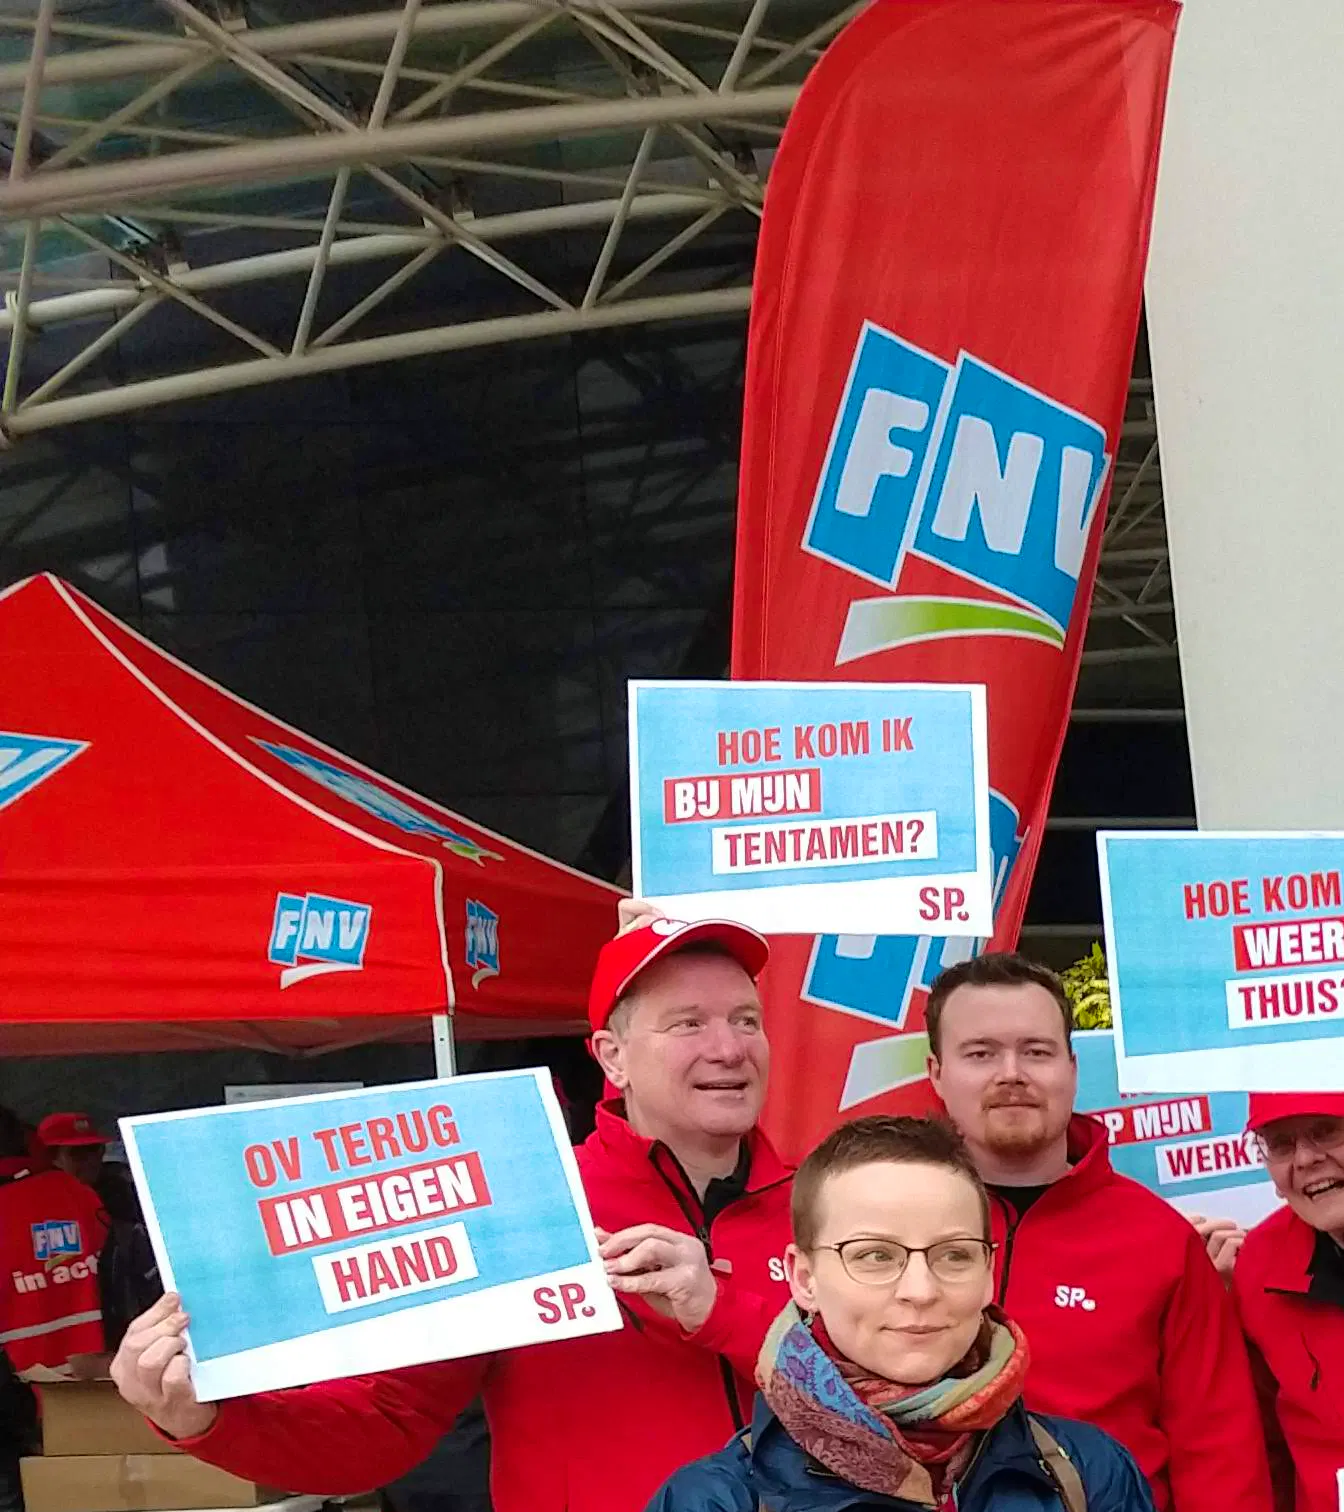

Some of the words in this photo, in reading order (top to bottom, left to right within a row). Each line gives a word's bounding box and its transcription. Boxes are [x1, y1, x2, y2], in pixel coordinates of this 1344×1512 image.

[717, 727, 782, 766] HOE
[794, 720, 870, 760] KOM
[882, 717, 914, 752] IK
[674, 780, 719, 820] BIJ
[731, 772, 811, 816] MIJN
[724, 819, 925, 867] TENTAMEN?
[1184, 879, 1251, 919] HOE
[1262, 870, 1341, 913] KOM
[275, 909, 366, 950] FNV
[244, 1136, 302, 1188] OV
[314, 1104, 461, 1172] TERUG
[1093, 1112, 1125, 1145] P
[1133, 1099, 1204, 1141] MIJN
[274, 1194, 332, 1248] IN
[336, 1160, 477, 1231] EIGEN
[12, 1270, 48, 1294] in
[331, 1235, 458, 1303] HAND
